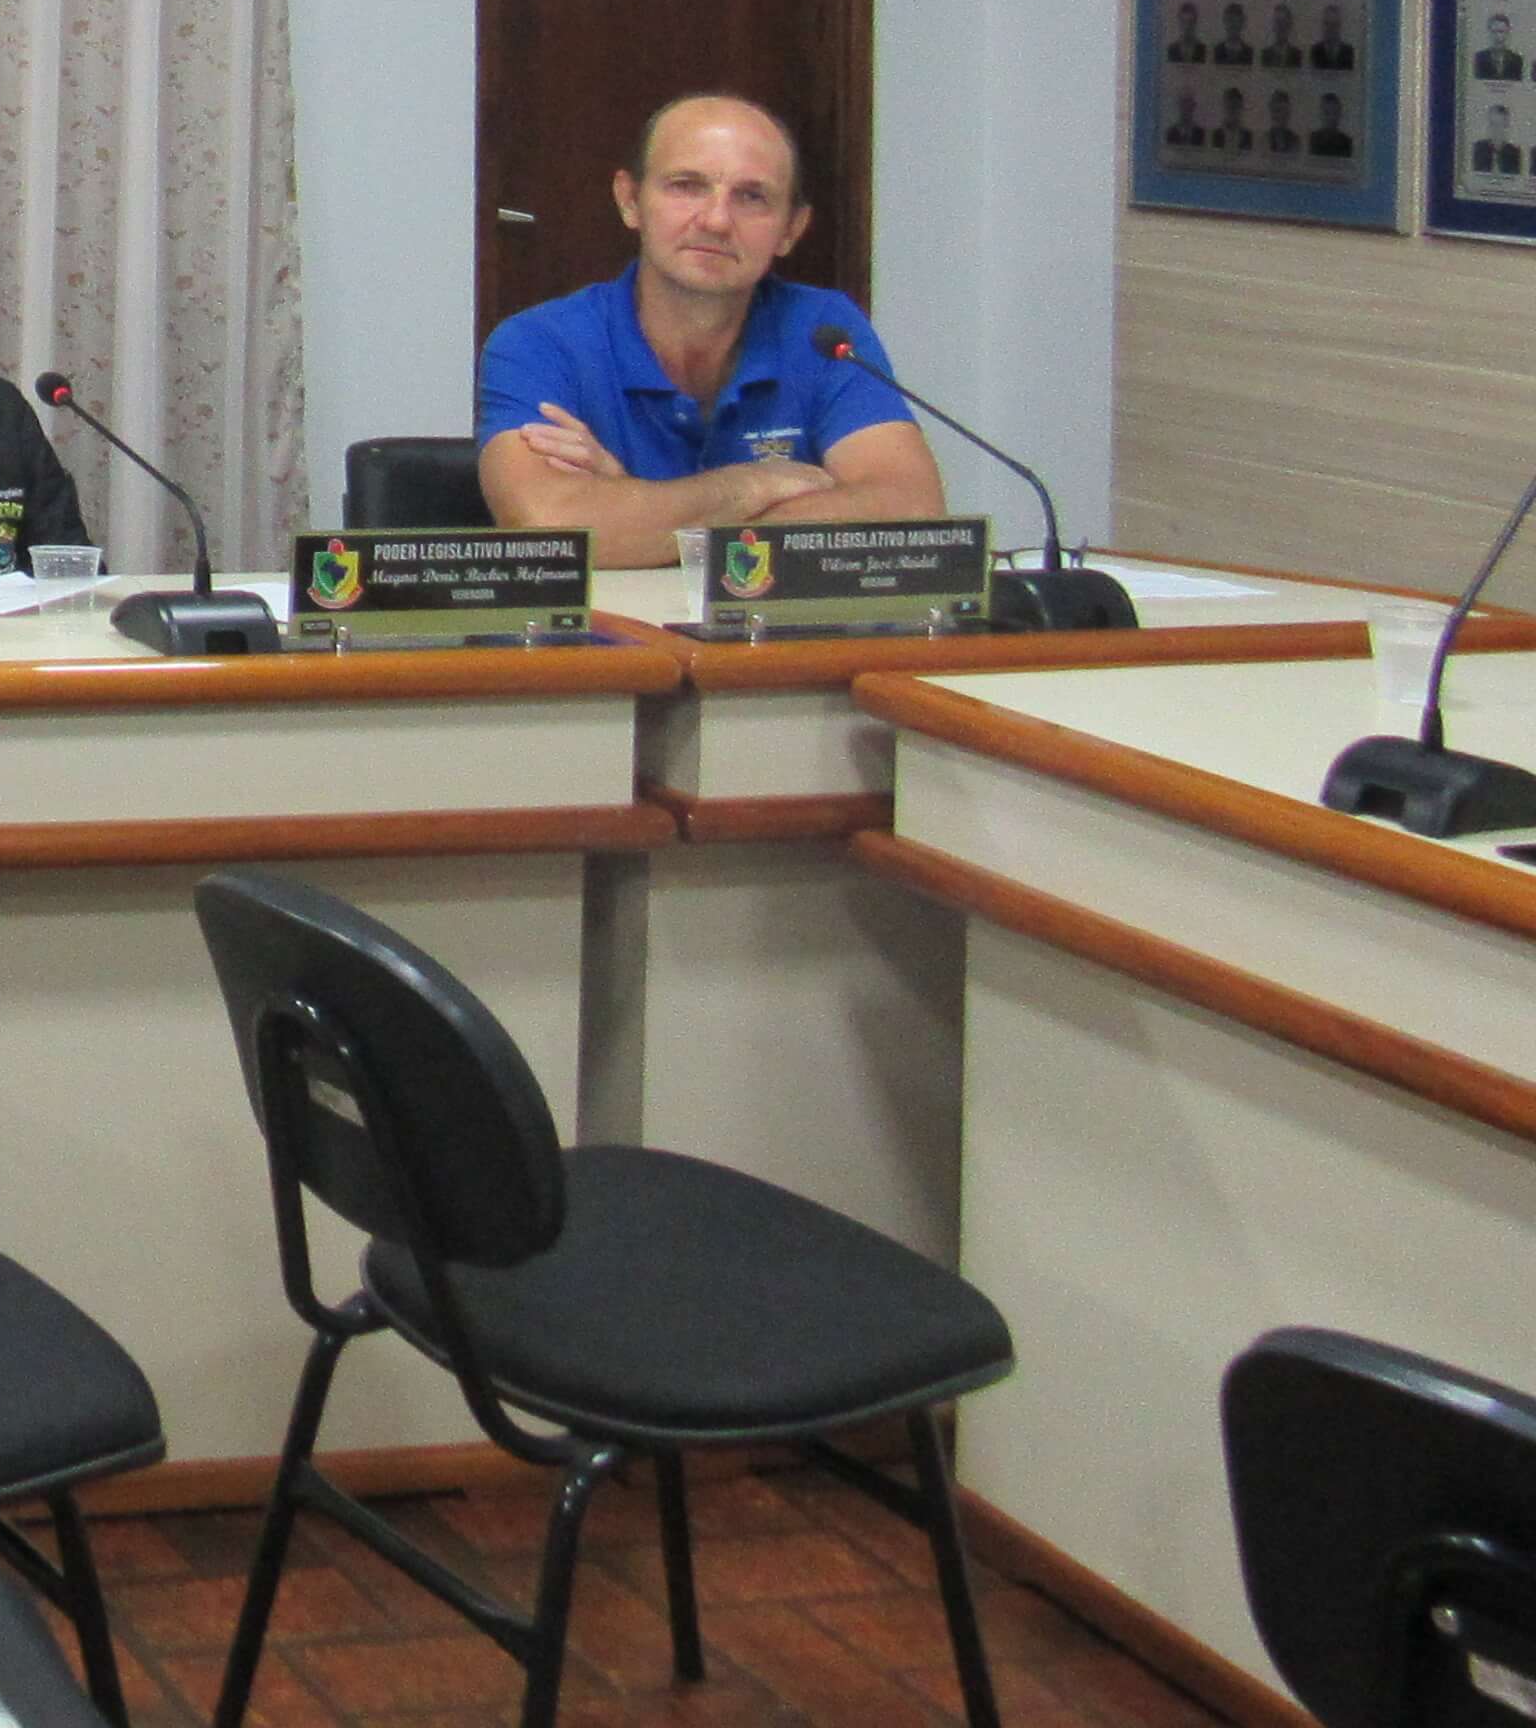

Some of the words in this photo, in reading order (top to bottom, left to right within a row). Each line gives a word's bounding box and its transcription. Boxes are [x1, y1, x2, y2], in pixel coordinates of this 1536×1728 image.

[783, 534, 824, 550] PODER
[827, 531, 905, 549] LEGISLATIVO
[907, 528, 974, 547] MUNICIPAL
[374, 543, 417, 561] PODER
[420, 542, 501, 560] LEGISLATIVO
[505, 540, 577, 559] MUNICIPAL
